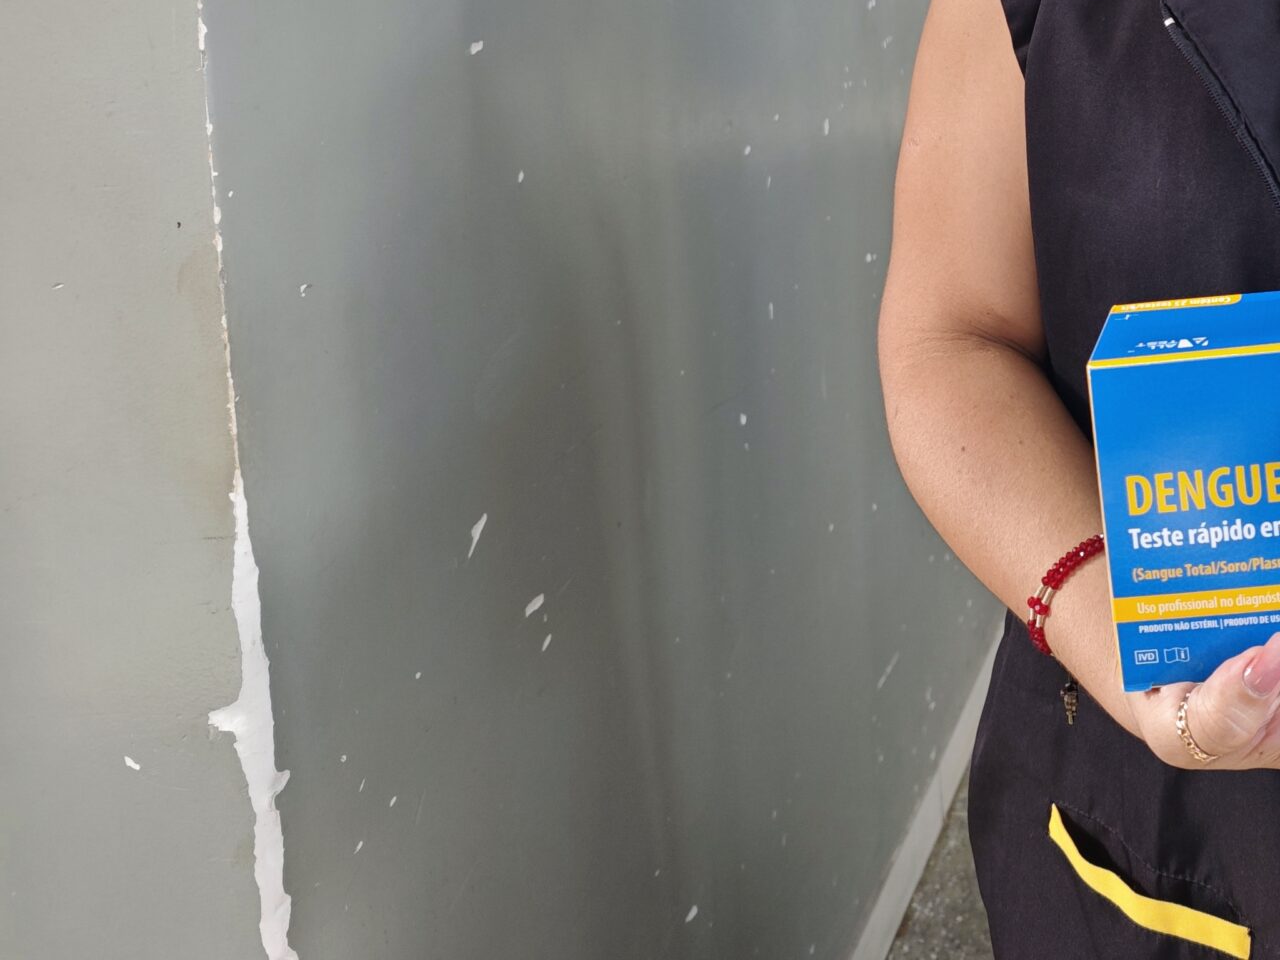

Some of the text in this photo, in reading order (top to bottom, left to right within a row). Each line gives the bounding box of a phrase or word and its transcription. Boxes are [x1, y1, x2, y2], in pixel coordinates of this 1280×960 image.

[1128, 526, 1184, 550] Teste
[1188, 518, 1256, 548] rápido
[1132, 566, 1183, 582] (Sangue
[1136, 601, 1157, 614] Uso
[1158, 596, 1218, 616] profissional
[1220, 598, 1234, 608] no
[1138, 623, 1174, 634] PRODUTO
[1174, 620, 1190, 631] NÃO
[1191, 618, 1219, 630] ESTÉRIL
[1224, 616, 1258, 627] PRODUTO
[1259, 615, 1269, 624] DE
[1137, 652, 1155, 662] IVD
